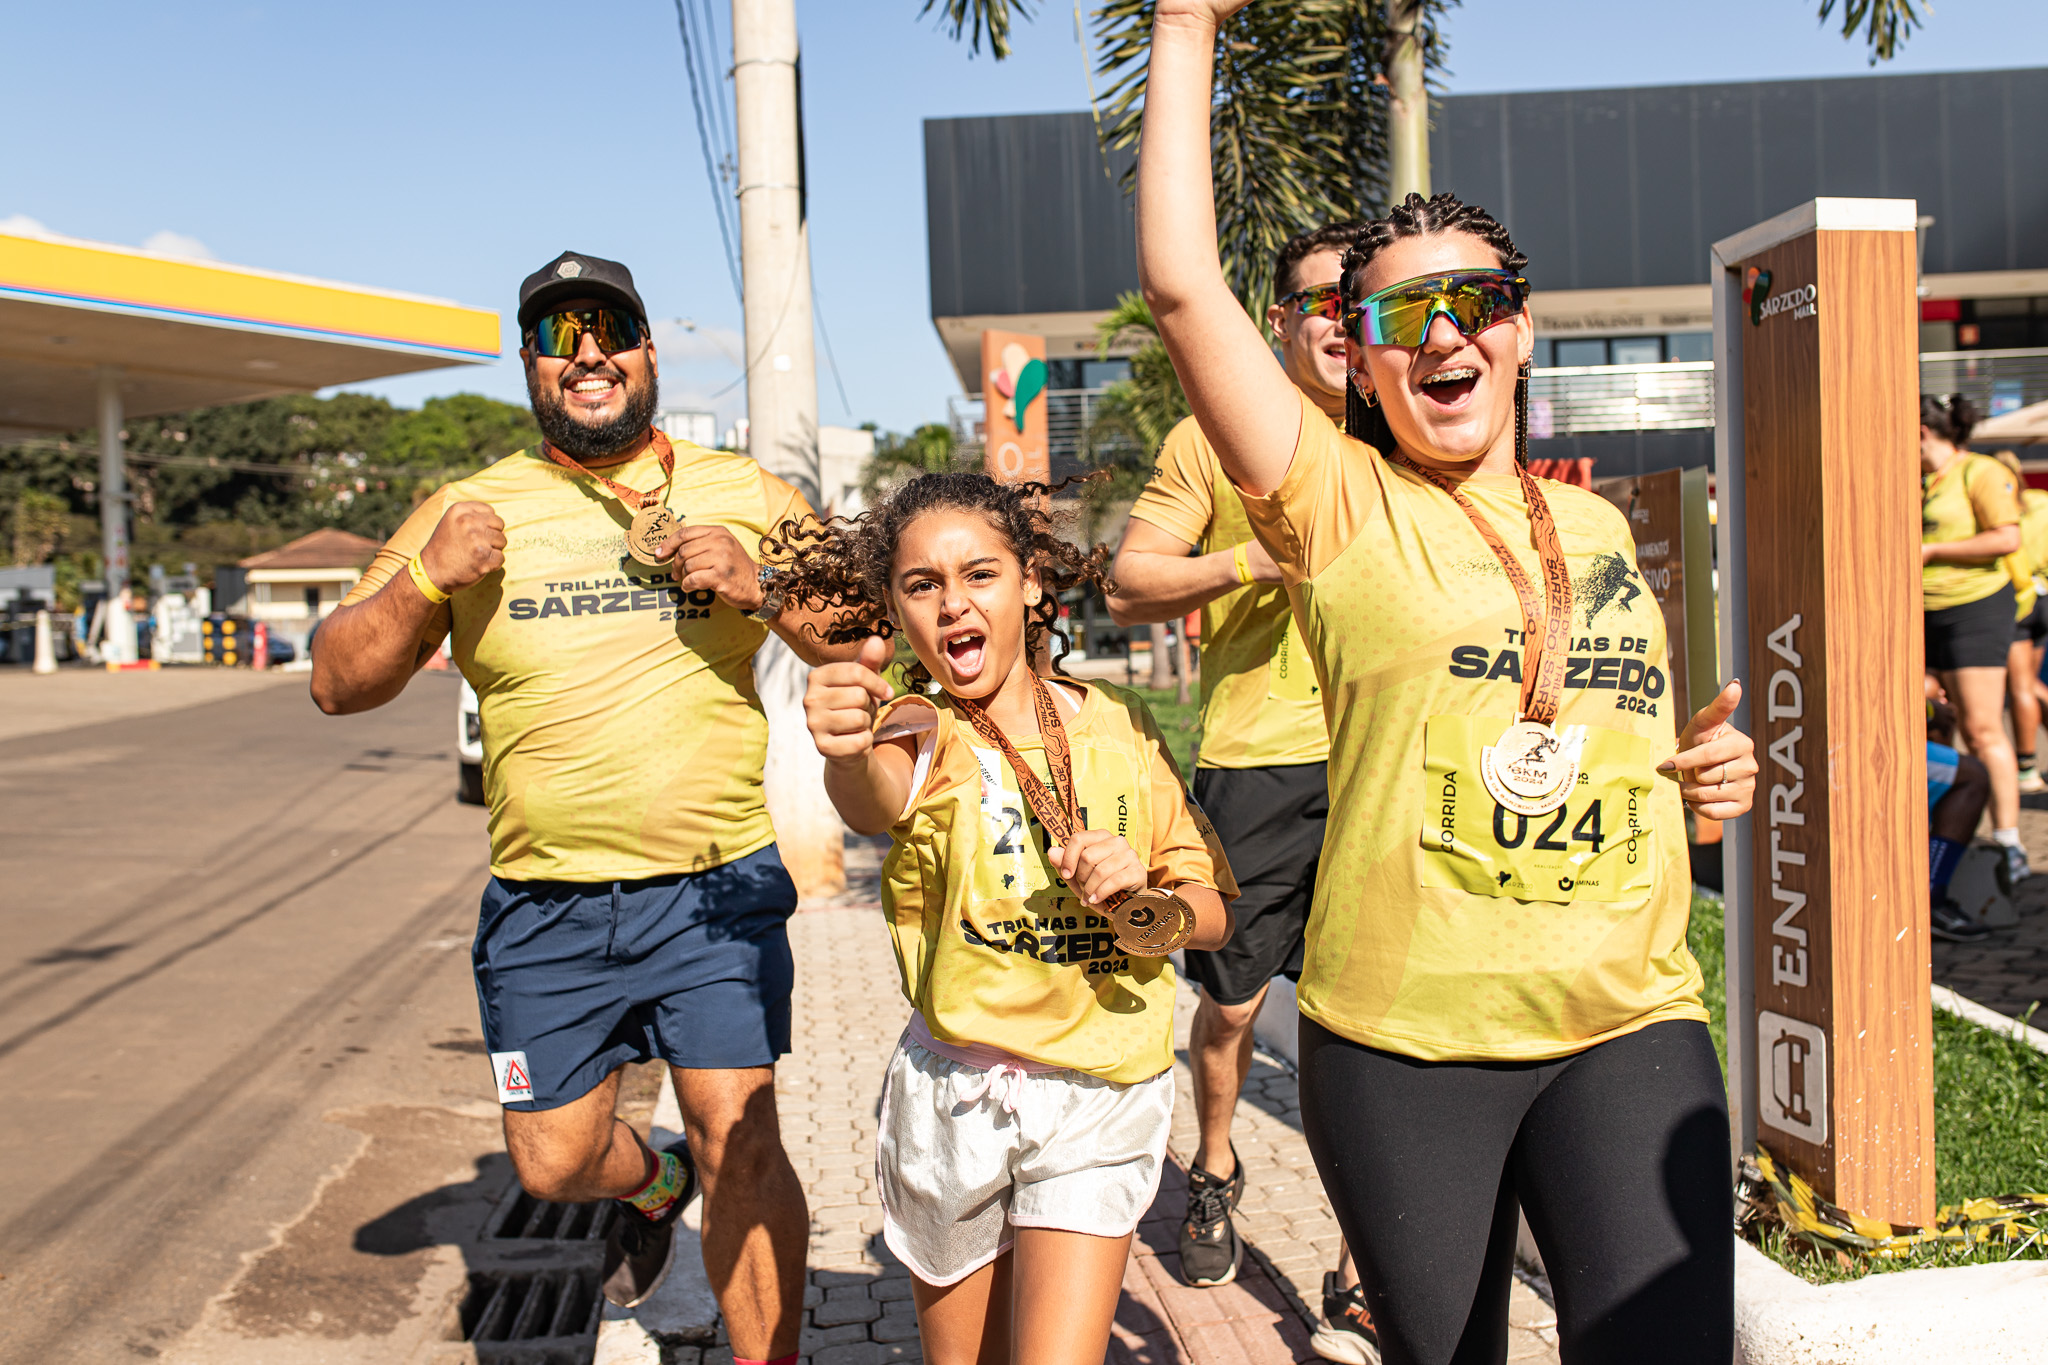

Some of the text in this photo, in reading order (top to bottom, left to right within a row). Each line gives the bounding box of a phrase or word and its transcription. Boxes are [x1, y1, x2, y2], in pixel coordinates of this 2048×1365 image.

[1760, 284, 1816, 320] SARZEDO
[545, 575, 642, 593] TRILHAS
[1559, 562, 1571, 615] TRILHAS
[508, 588, 716, 620] SARZEDO
[659, 608, 711, 622] 2024
[1546, 558, 1562, 652] SARZEDO
[1280, 632, 1289, 679] CORRIDA
[1619, 636, 1649, 654] DE
[1449, 645, 1666, 700] SAZEDO
[1615, 695, 1658, 718] 2024
[1511, 766, 1547, 780] 6KM
[1513, 775, 1544, 785] 2024
[1028, 771, 1061, 817] TRILHAS
[1767, 613, 1808, 988] ENTRADA
[1440, 770, 1457, 854] CORRIDA
[1493, 798, 1605, 854] 024
[1626, 786, 1643, 865] CORRIDA
[987, 915, 1077, 935] TRILHAS
[1136, 911, 1176, 943] ITAMINAS
[1088, 958, 1129, 975] 2024
